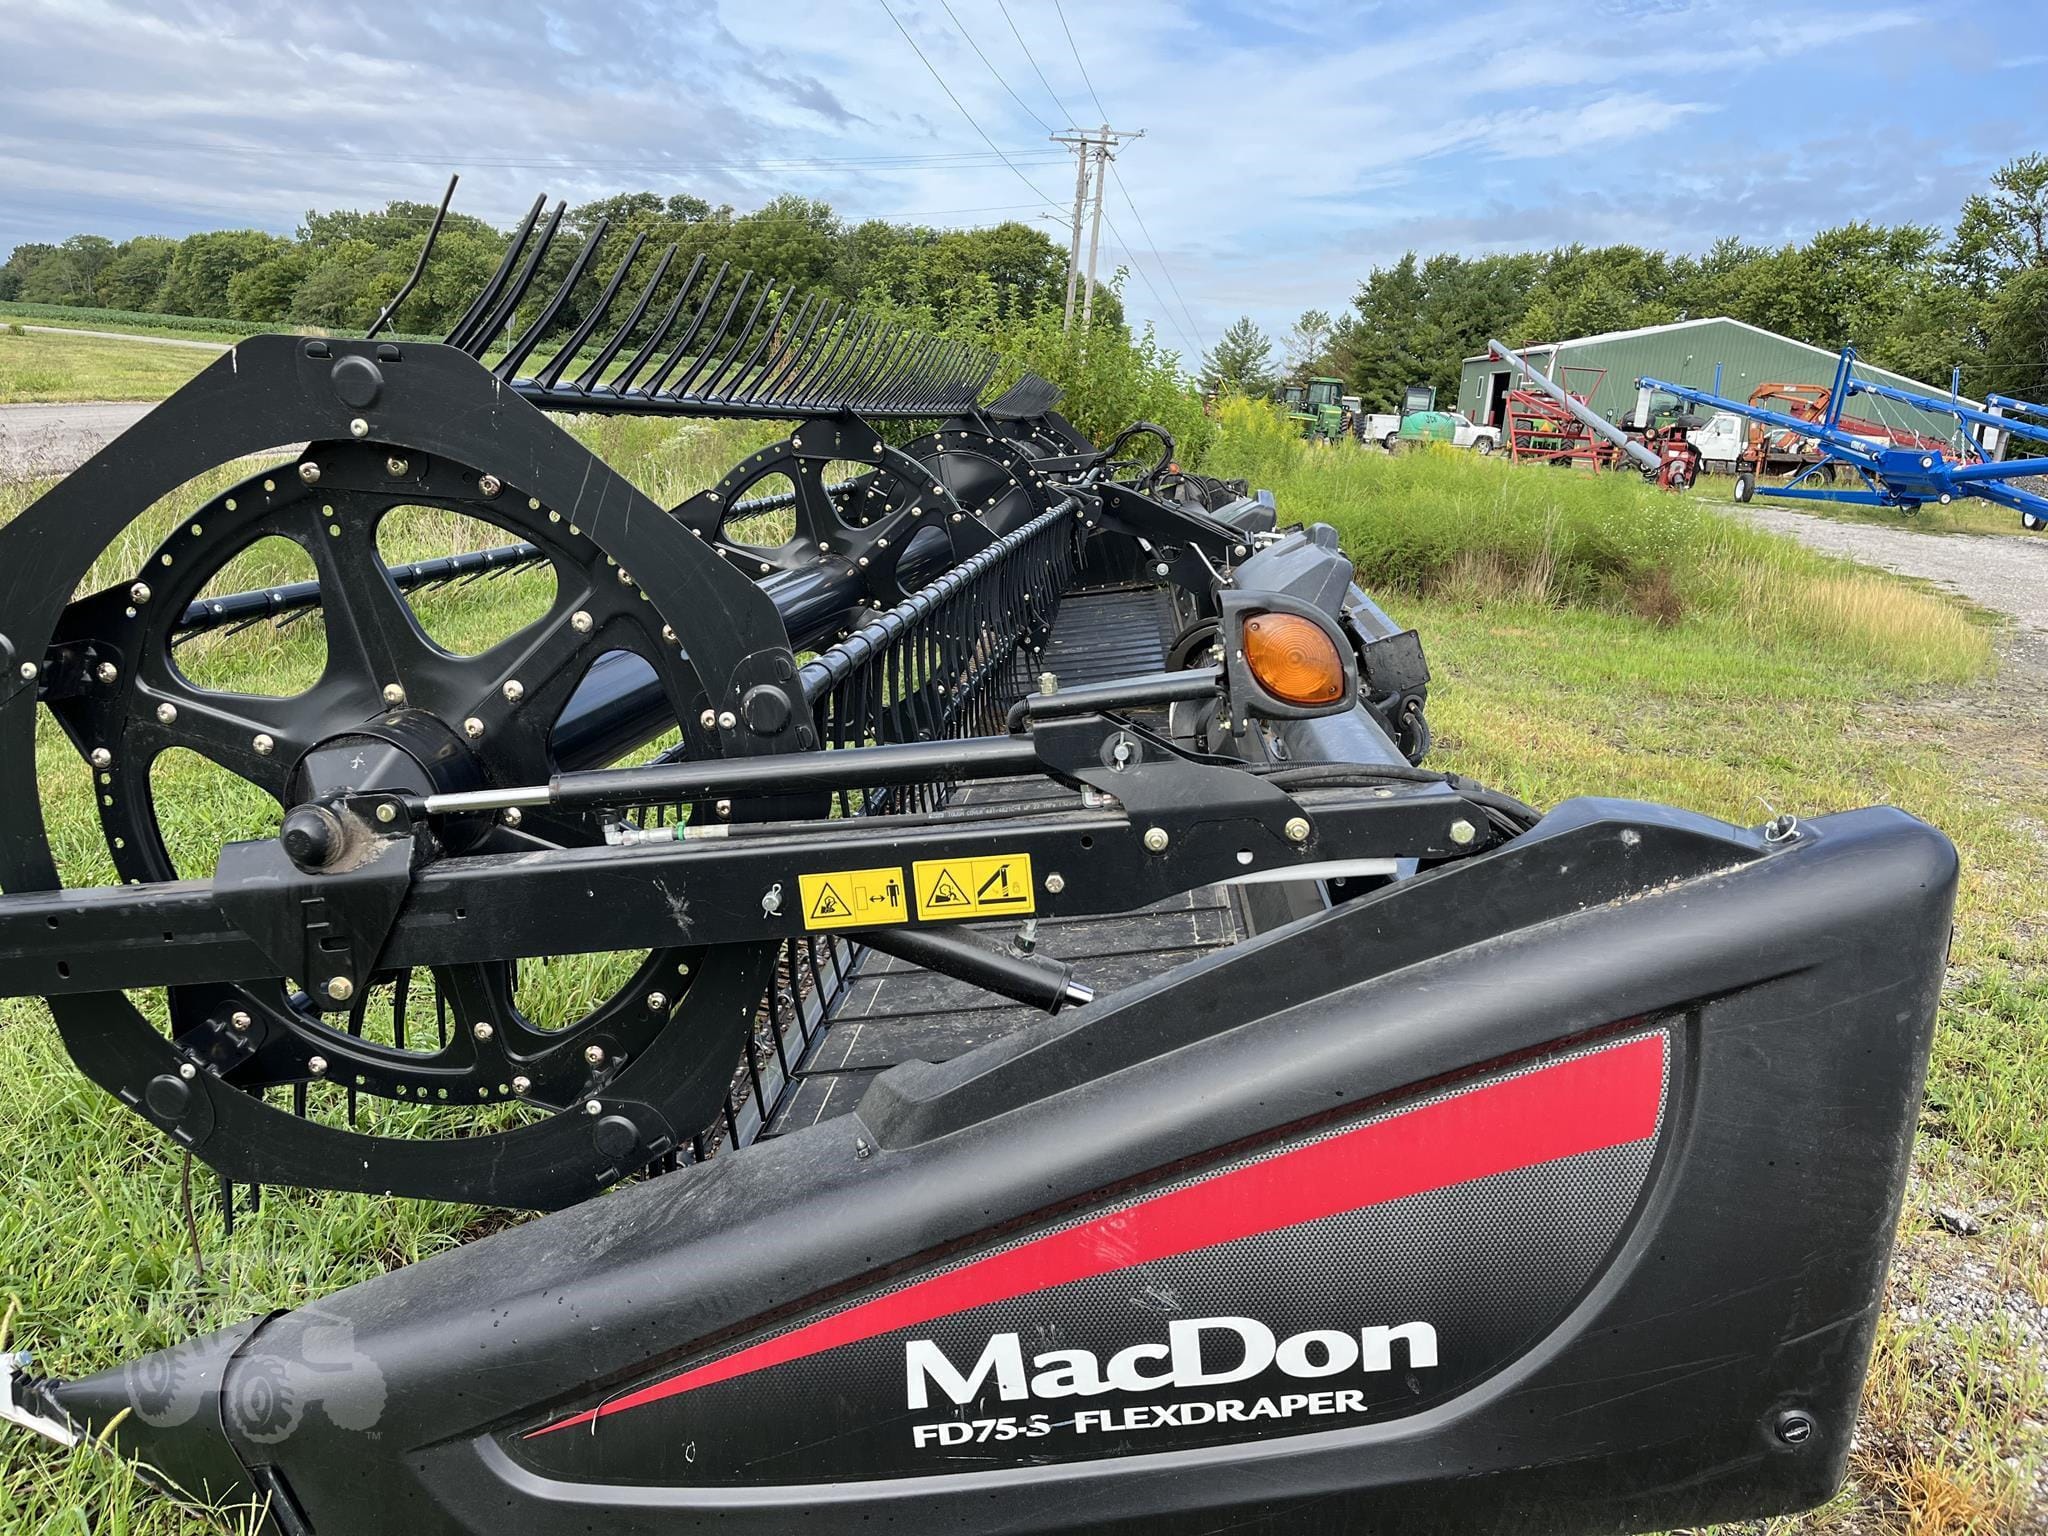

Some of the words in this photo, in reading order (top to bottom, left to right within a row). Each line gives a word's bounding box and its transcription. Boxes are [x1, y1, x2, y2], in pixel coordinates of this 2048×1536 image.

[905, 1315, 1438, 1410] MacDon
[912, 1413, 1051, 1448] FD75-S
[1075, 1389, 1368, 1434] FLEXDRAPER
